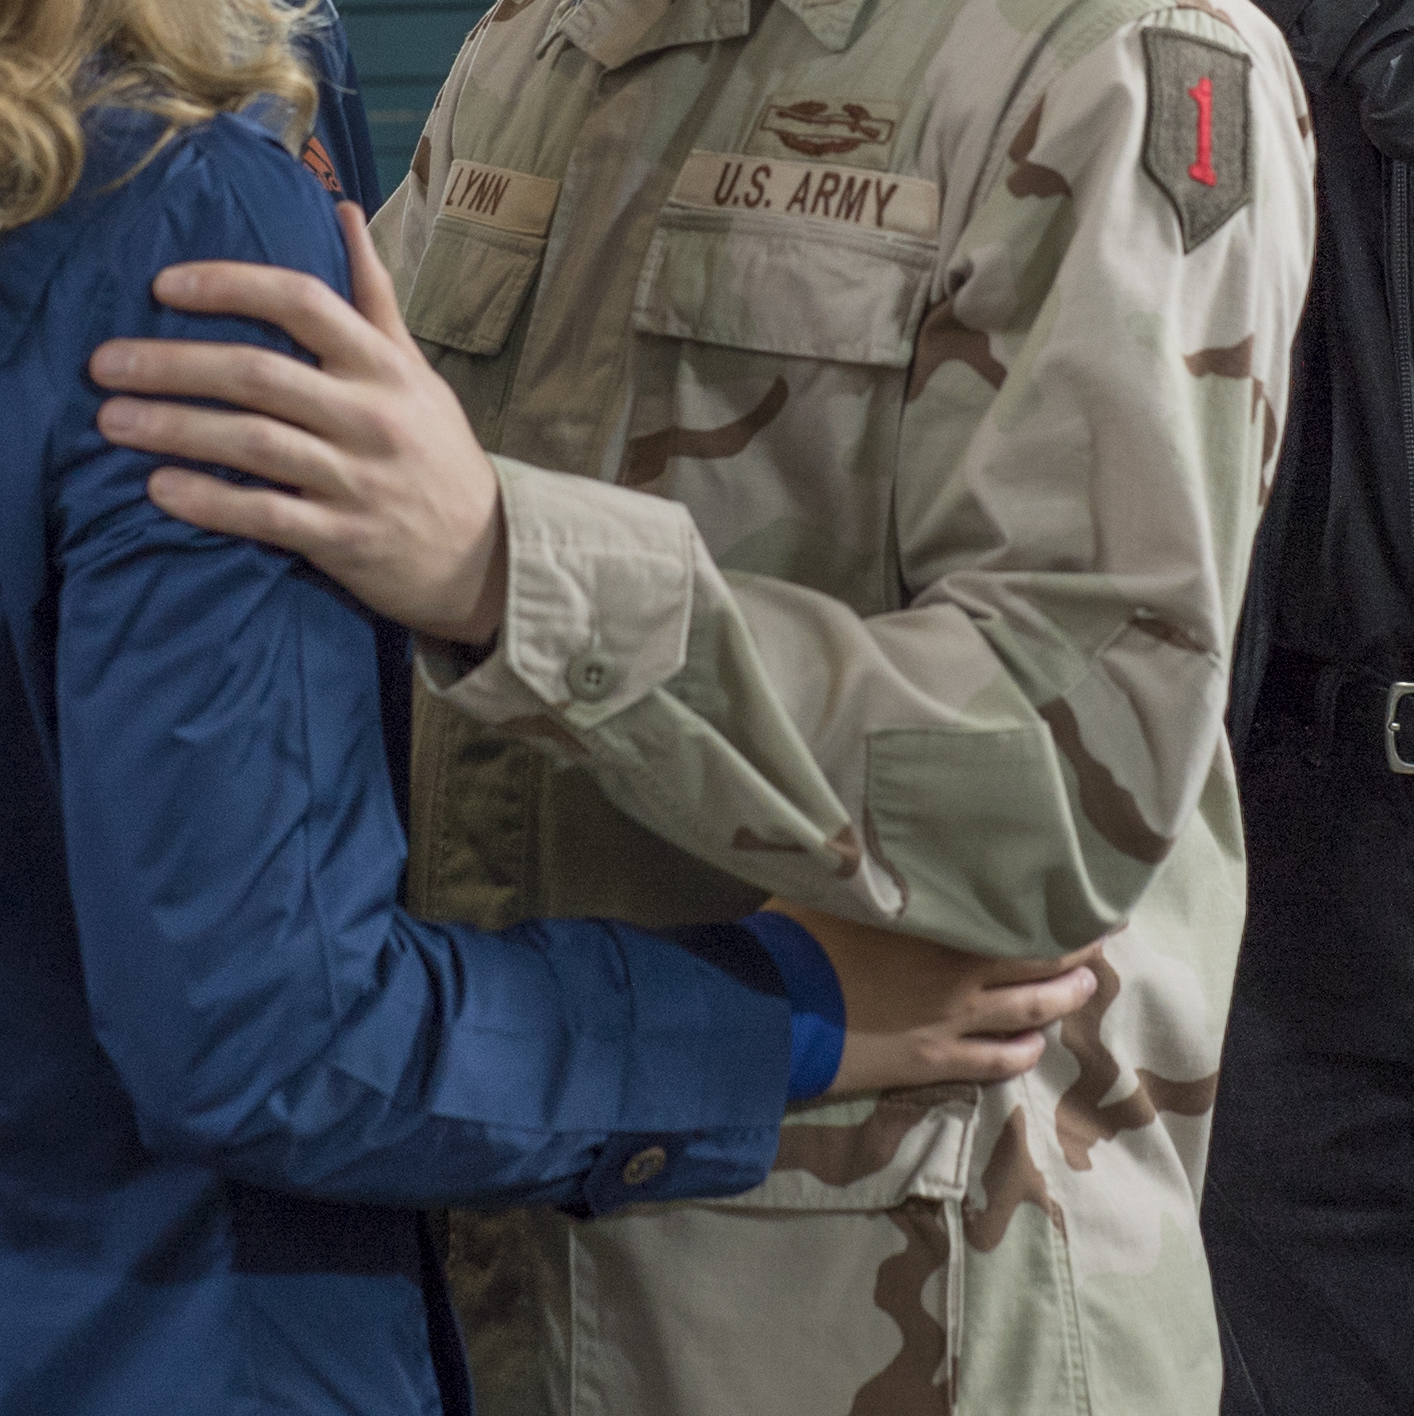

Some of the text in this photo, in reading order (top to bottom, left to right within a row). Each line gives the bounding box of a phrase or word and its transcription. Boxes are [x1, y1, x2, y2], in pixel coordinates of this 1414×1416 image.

[1188, 77, 1217, 186] 1
[444, 166, 512, 217] LYNN
[713, 161, 898, 229] U.S. ARMY
